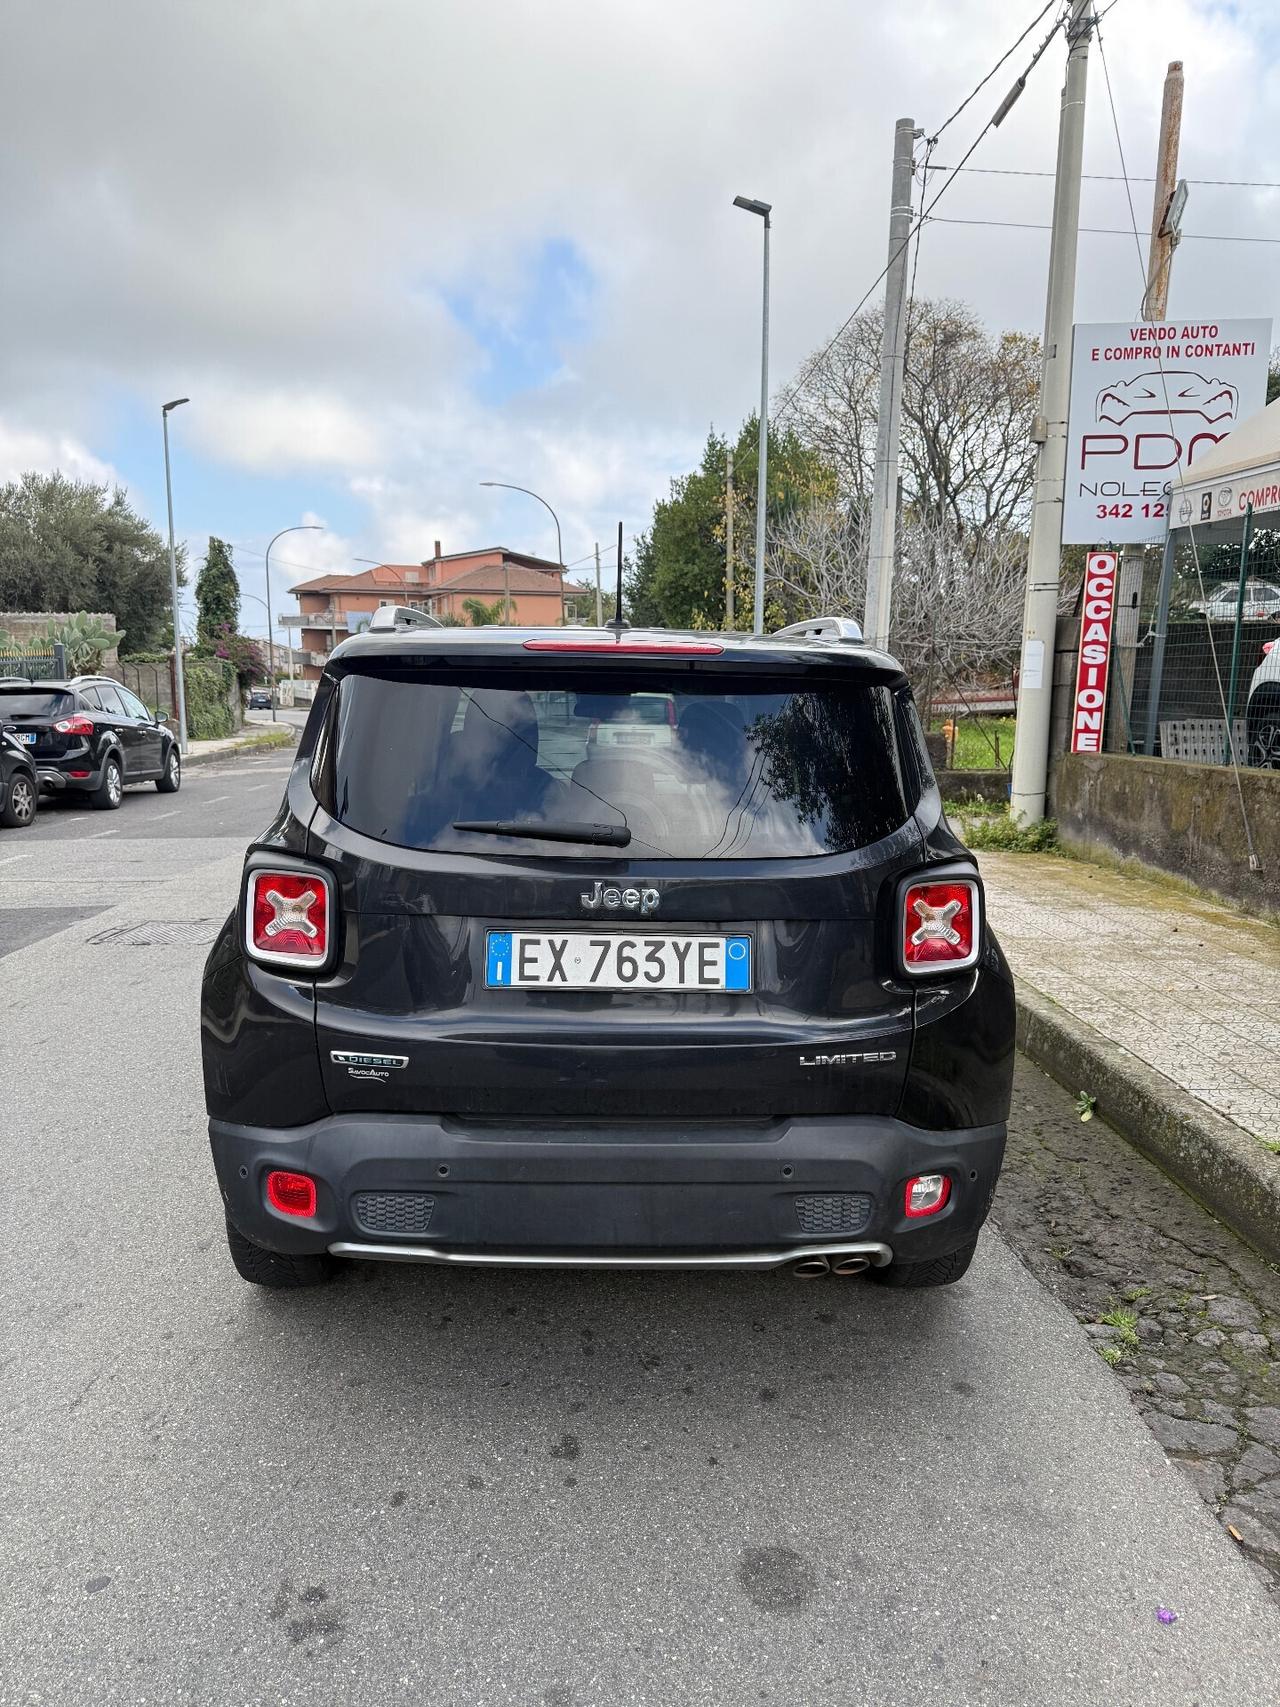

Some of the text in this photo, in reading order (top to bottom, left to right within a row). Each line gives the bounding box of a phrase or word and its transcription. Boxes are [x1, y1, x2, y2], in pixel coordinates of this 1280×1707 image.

[1130, 325, 1219, 341] VENDO AUTO
[1091, 342, 1255, 361] E COMPRO IN CONTANTI
[1238, 484, 1280, 511] COMPR
[1096, 503, 1170, 519] 342 12
[1076, 554, 1116, 752] OCCASIONE
[581, 882, 661, 914] Jeep
[518, 938, 569, 983] EX
[589, 940, 721, 985] 763YE
[349, 1056, 401, 1066] DIESEL
[799, 1051, 897, 1066] LIMITED
